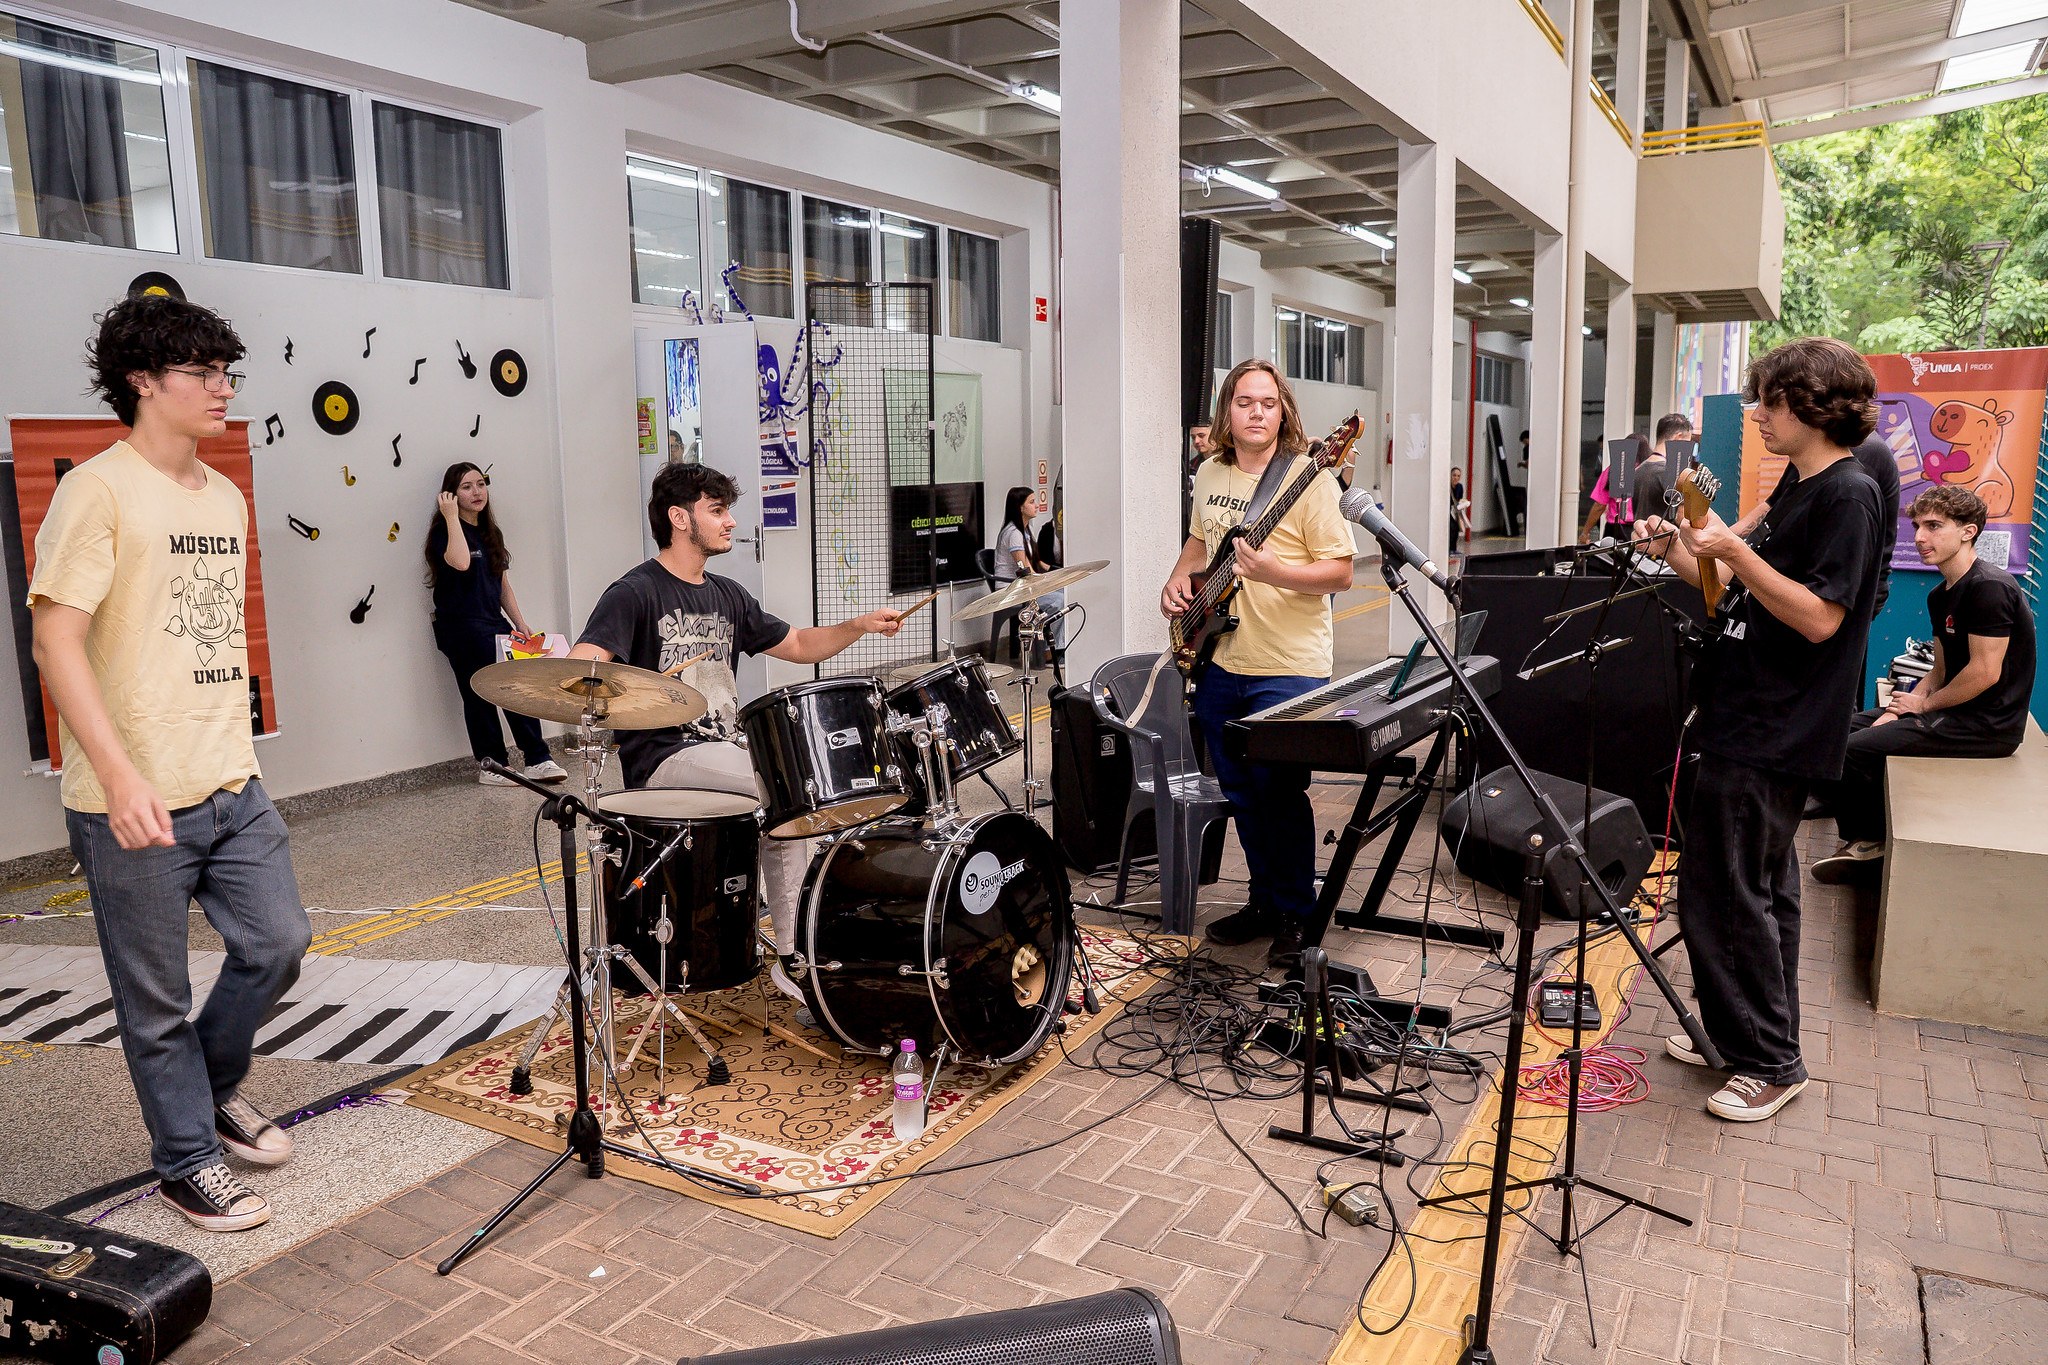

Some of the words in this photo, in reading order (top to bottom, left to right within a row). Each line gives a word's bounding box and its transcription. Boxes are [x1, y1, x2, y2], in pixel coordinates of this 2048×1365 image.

[1930, 363, 1962, 374] UNILA
[169, 532, 241, 555] MÚSICA
[193, 666, 244, 684] UNILA
[1378, 720, 1402, 747] YAMAHA
[981, 862, 1024, 890] SOUNDTRACK
